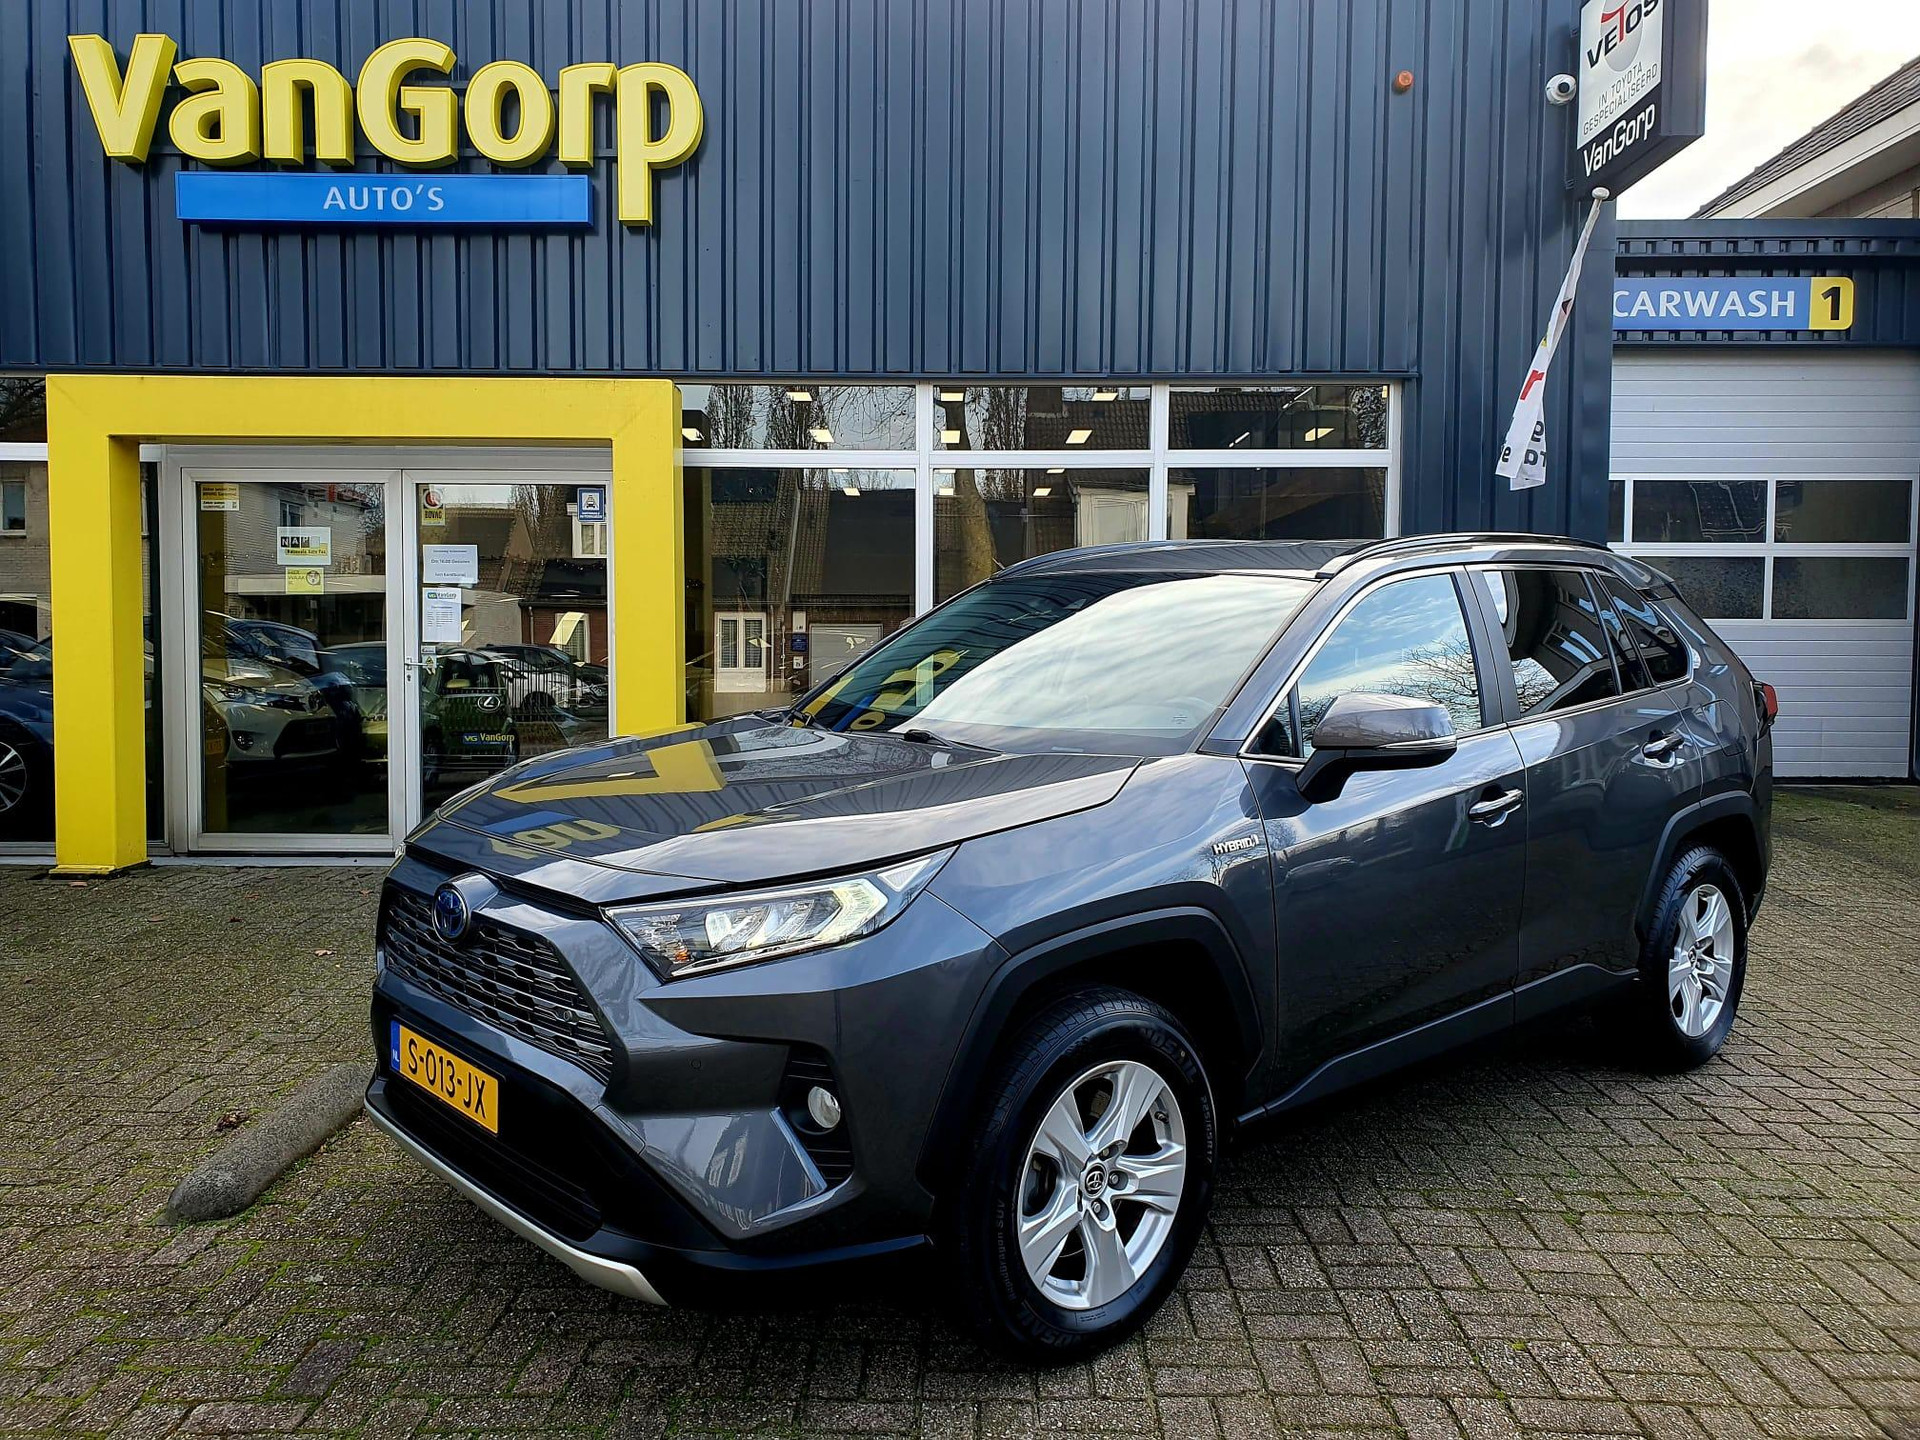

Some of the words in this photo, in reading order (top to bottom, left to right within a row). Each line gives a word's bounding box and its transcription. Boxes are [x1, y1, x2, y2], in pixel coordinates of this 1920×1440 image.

[1587, 0, 1659, 68] VETOS
[1583, 63, 1659, 136] GESPECIALISEERD
[1598, 94, 1608, 109] IN
[1611, 62, 1644, 97] TOYOTA
[67, 33, 704, 227] VanGorp
[1583, 103, 1656, 178] VanGorp
[322, 184, 446, 212] AUTO'S
[1612, 290, 1796, 318] CARWASH
[1820, 286, 1842, 321] 1
[464, 734, 478, 742] VG
[479, 732, 515, 745] VanGorp
[1212, 837, 1253, 856] HYBRID
[392, 1049, 400, 1063] NL
[407, 1037, 487, 1119] S-013-JX
